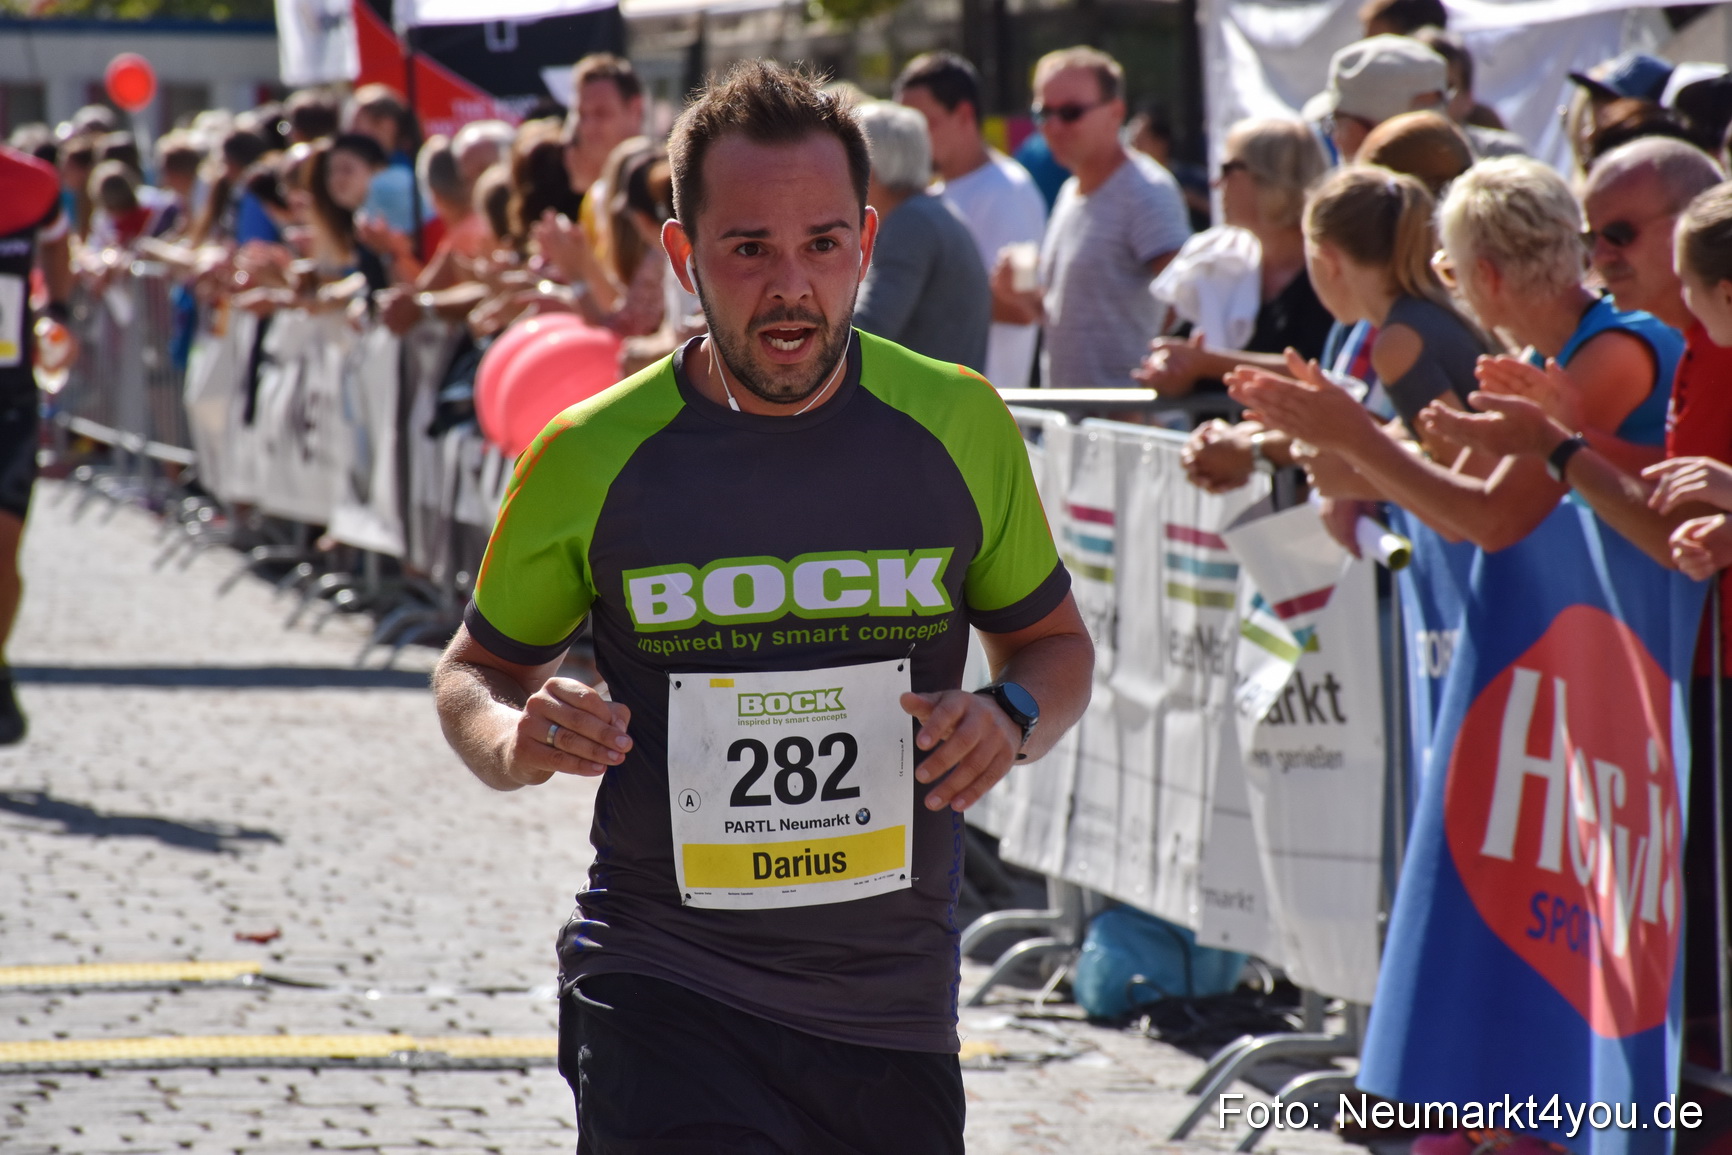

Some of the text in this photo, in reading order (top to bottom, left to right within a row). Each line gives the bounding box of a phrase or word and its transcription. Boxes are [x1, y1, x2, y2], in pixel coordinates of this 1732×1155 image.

[628, 556, 948, 626] BOCK
[638, 618, 949, 657] inspired by smart concepts
[739, 687, 845, 716] BOCK
[737, 712, 848, 727] inspired by smart concepts
[726, 732, 861, 807] 282
[685, 794, 695, 807] A
[724, 814, 851, 834] PARTL Neumarkt
[752, 848, 848, 880] Darius
